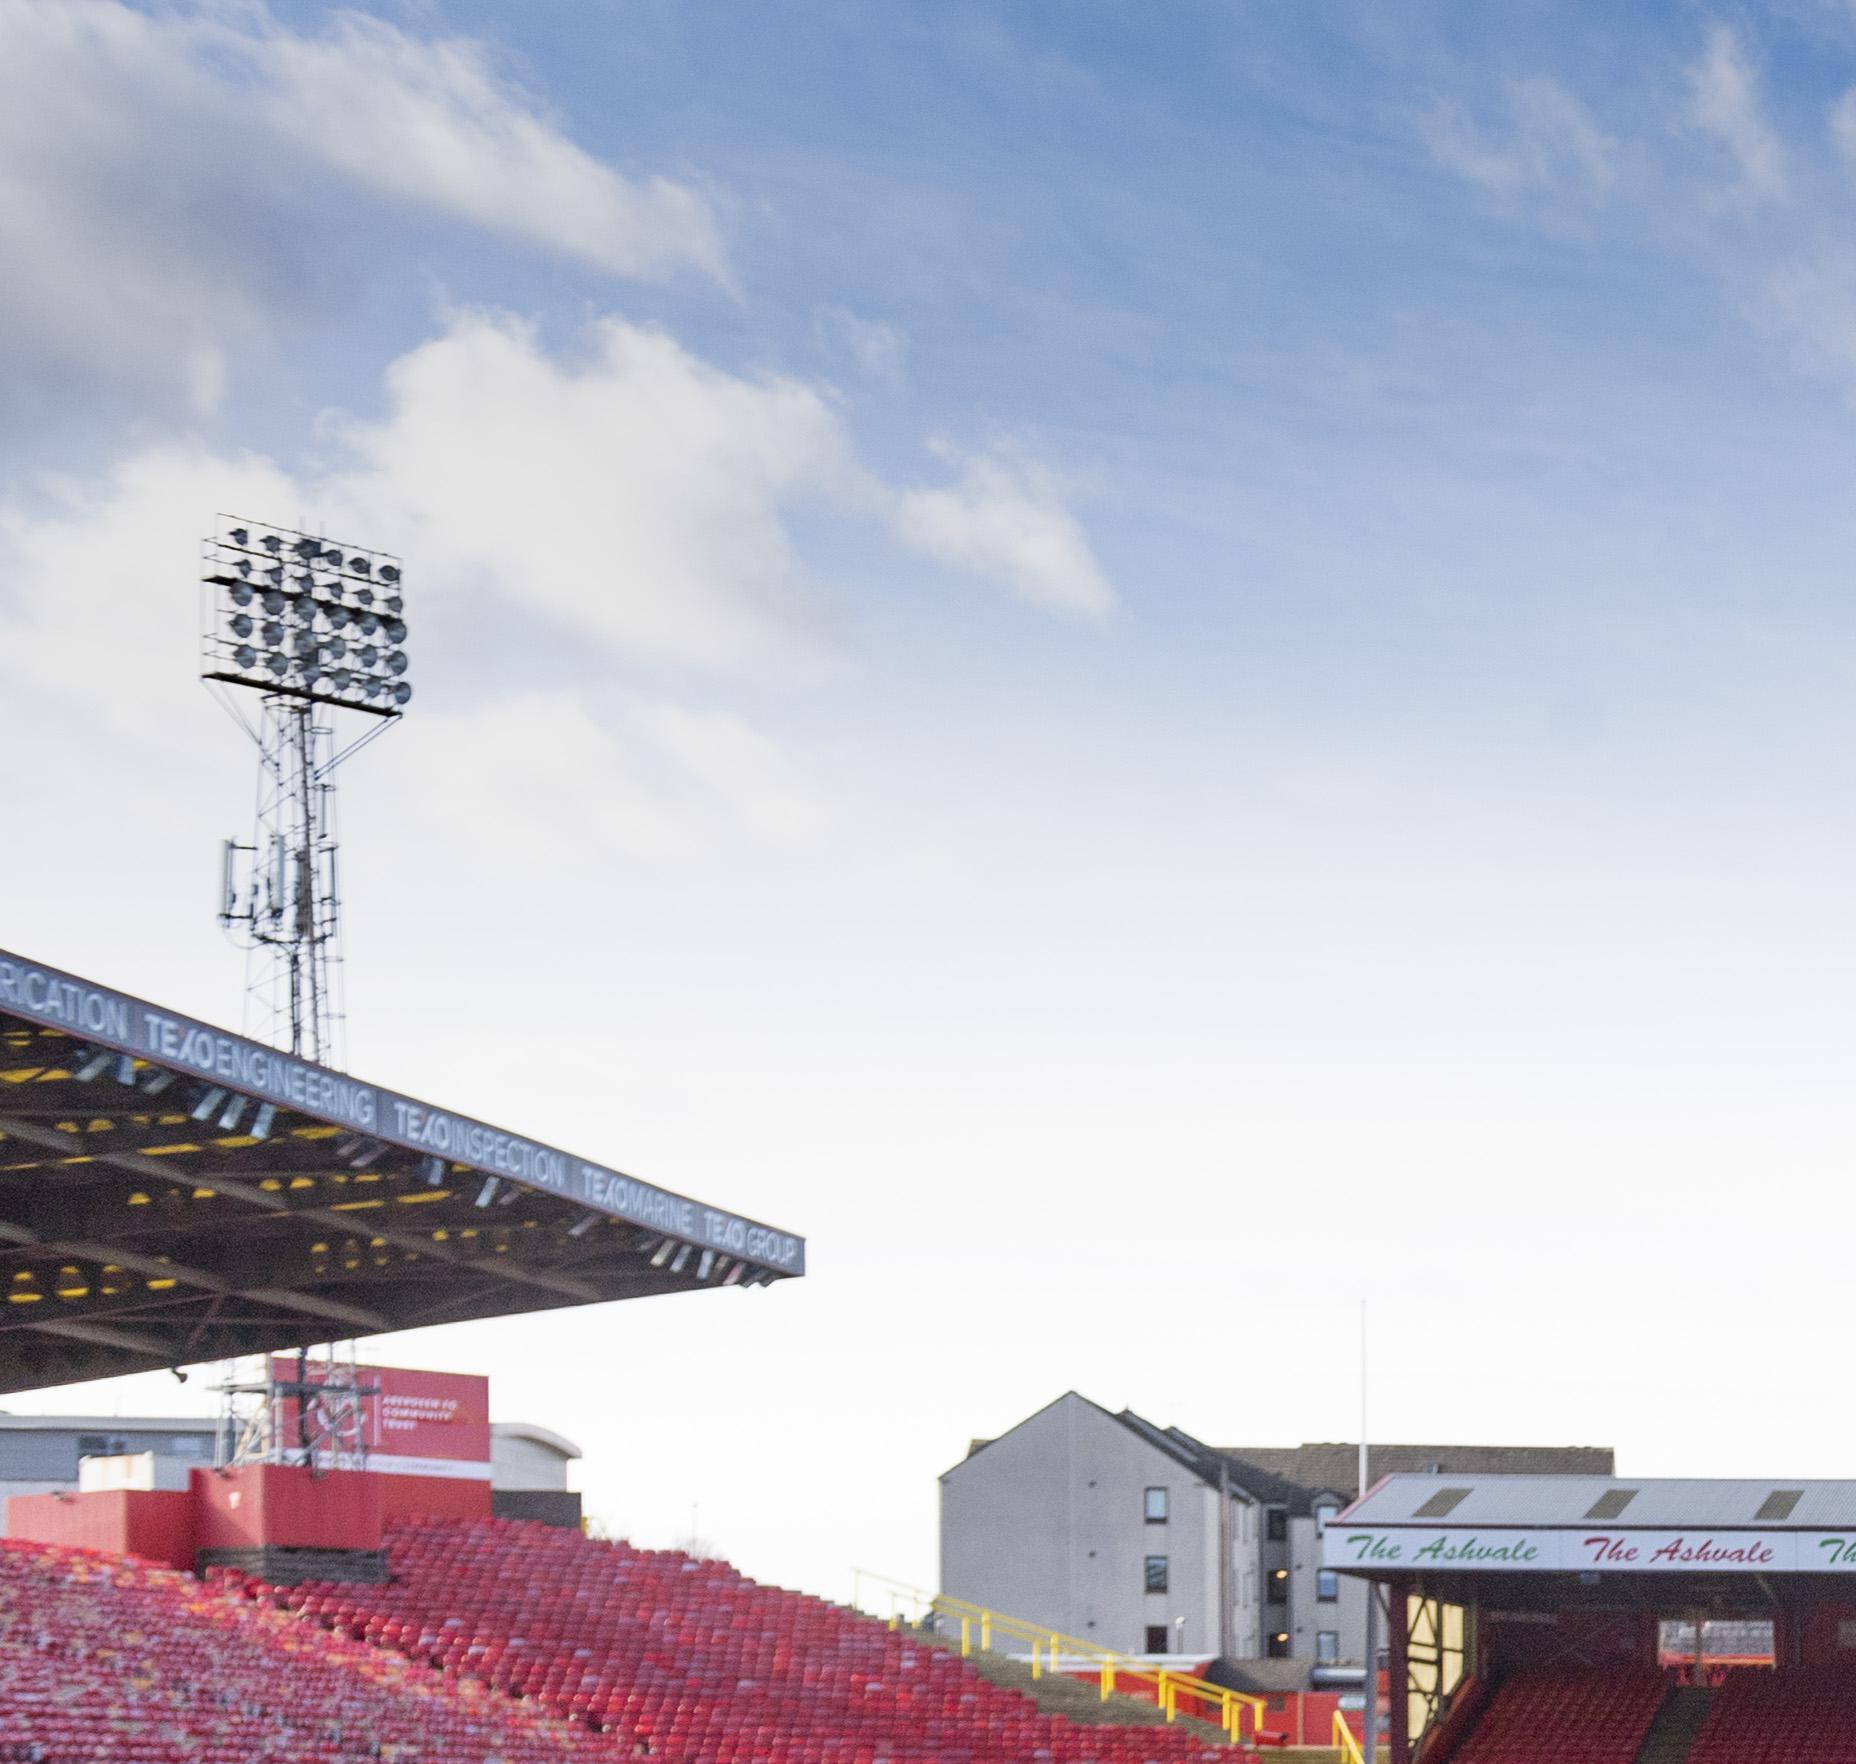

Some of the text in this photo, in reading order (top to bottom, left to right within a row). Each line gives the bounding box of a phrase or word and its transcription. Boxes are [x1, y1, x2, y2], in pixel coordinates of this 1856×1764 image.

[0, 961, 128, 1040] RICATION
[747, 1231, 797, 1265] GROUP
[1347, 1535, 1538, 1562] The Ashvale
[1584, 1538, 1773, 1564] The Ashvale
